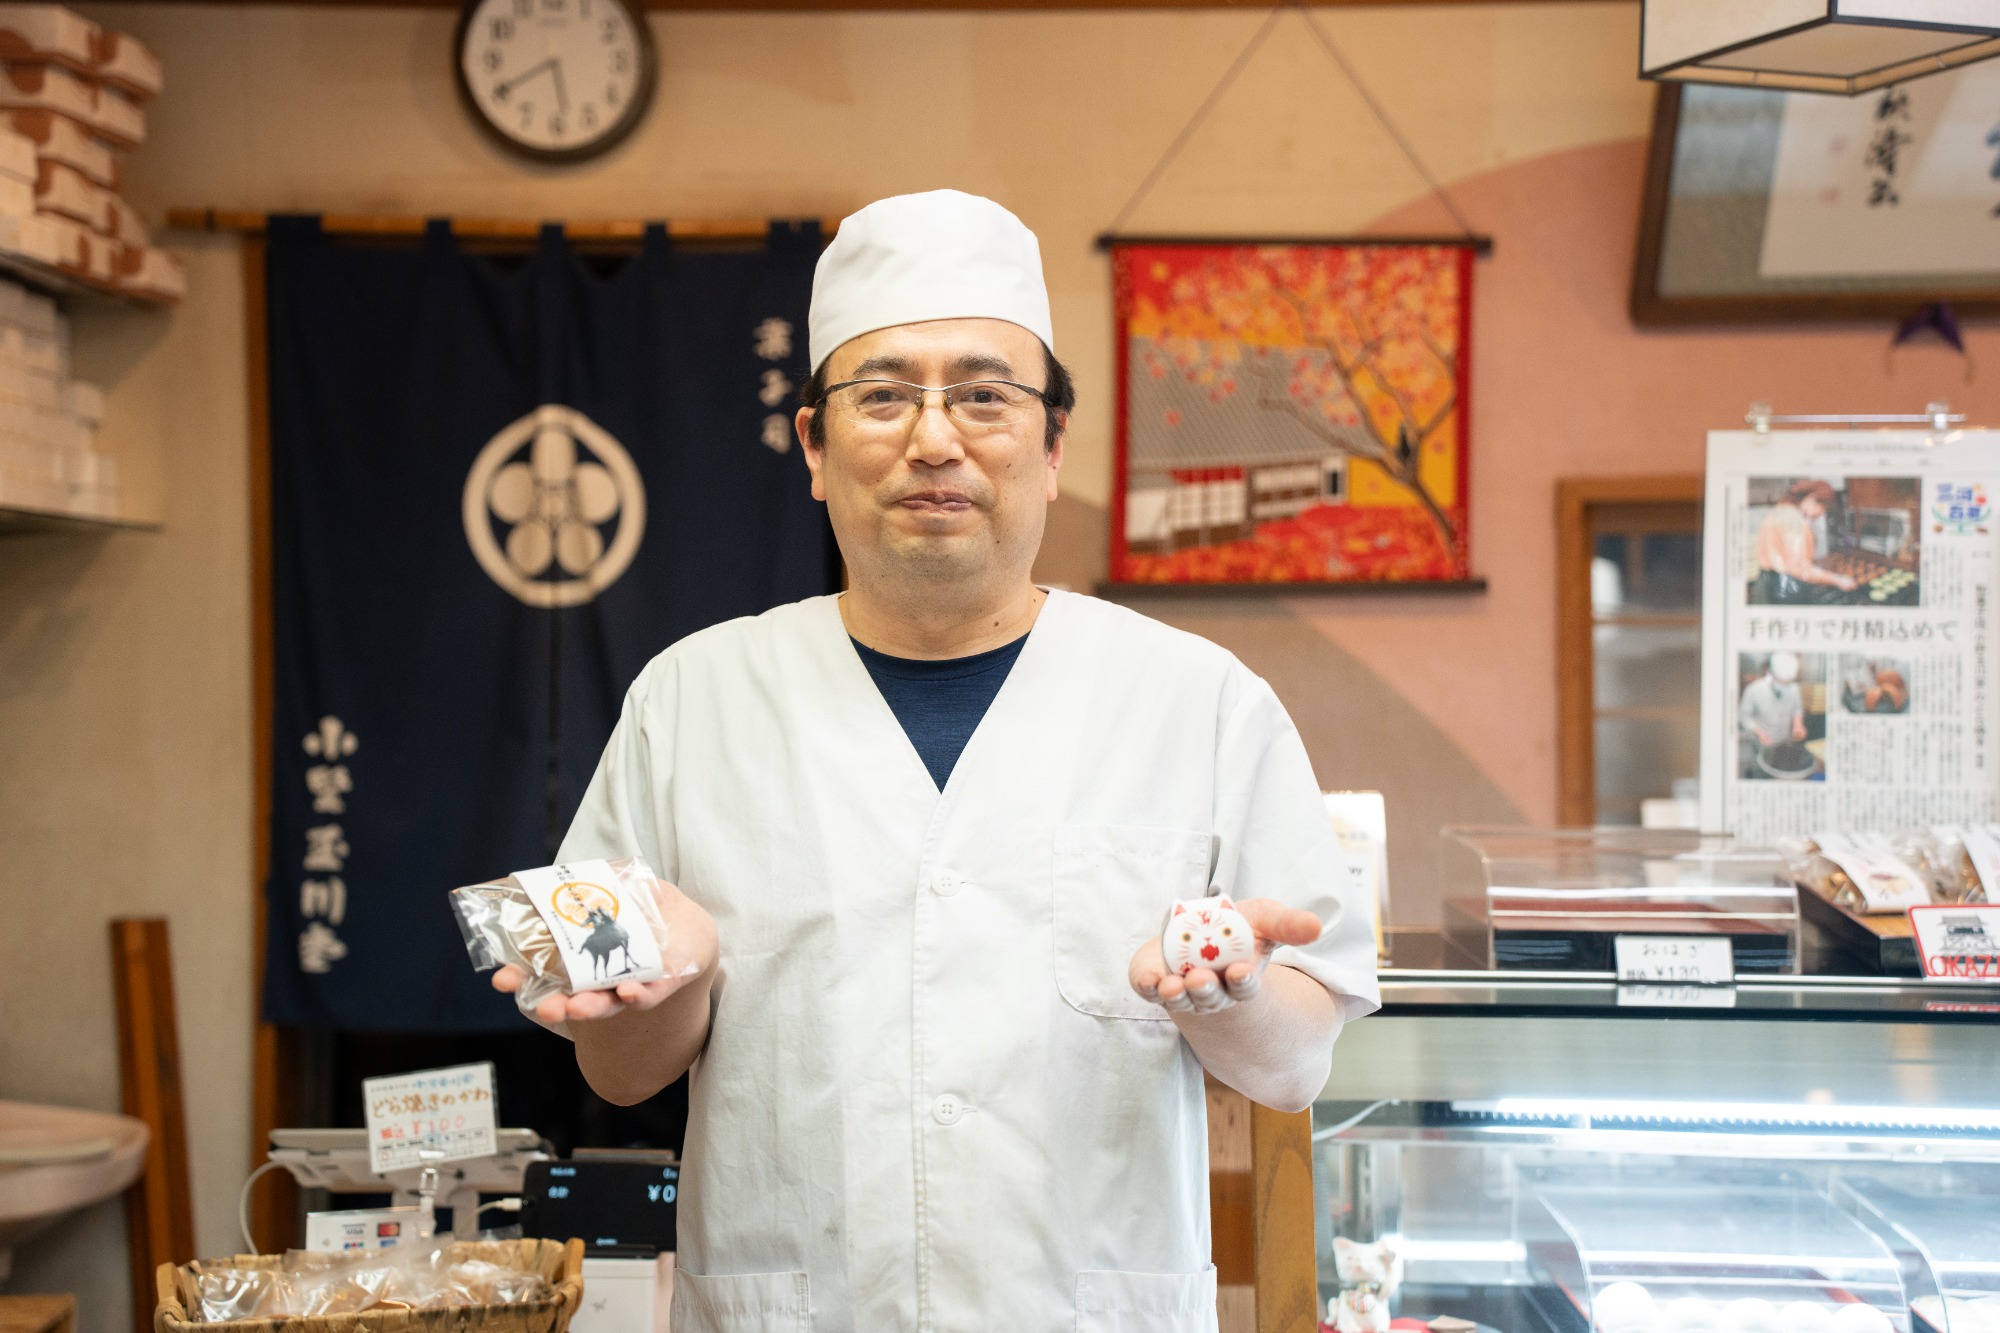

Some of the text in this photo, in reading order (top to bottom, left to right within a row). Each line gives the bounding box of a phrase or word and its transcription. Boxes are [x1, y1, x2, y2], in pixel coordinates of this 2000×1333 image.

[483, 48, 502, 74] 9
[1746, 616, 1958, 643] 手作りで丹精込めて
[1642, 943, 1704, 958] おはぎ
[648, 1185, 676, 1203] ¥0
